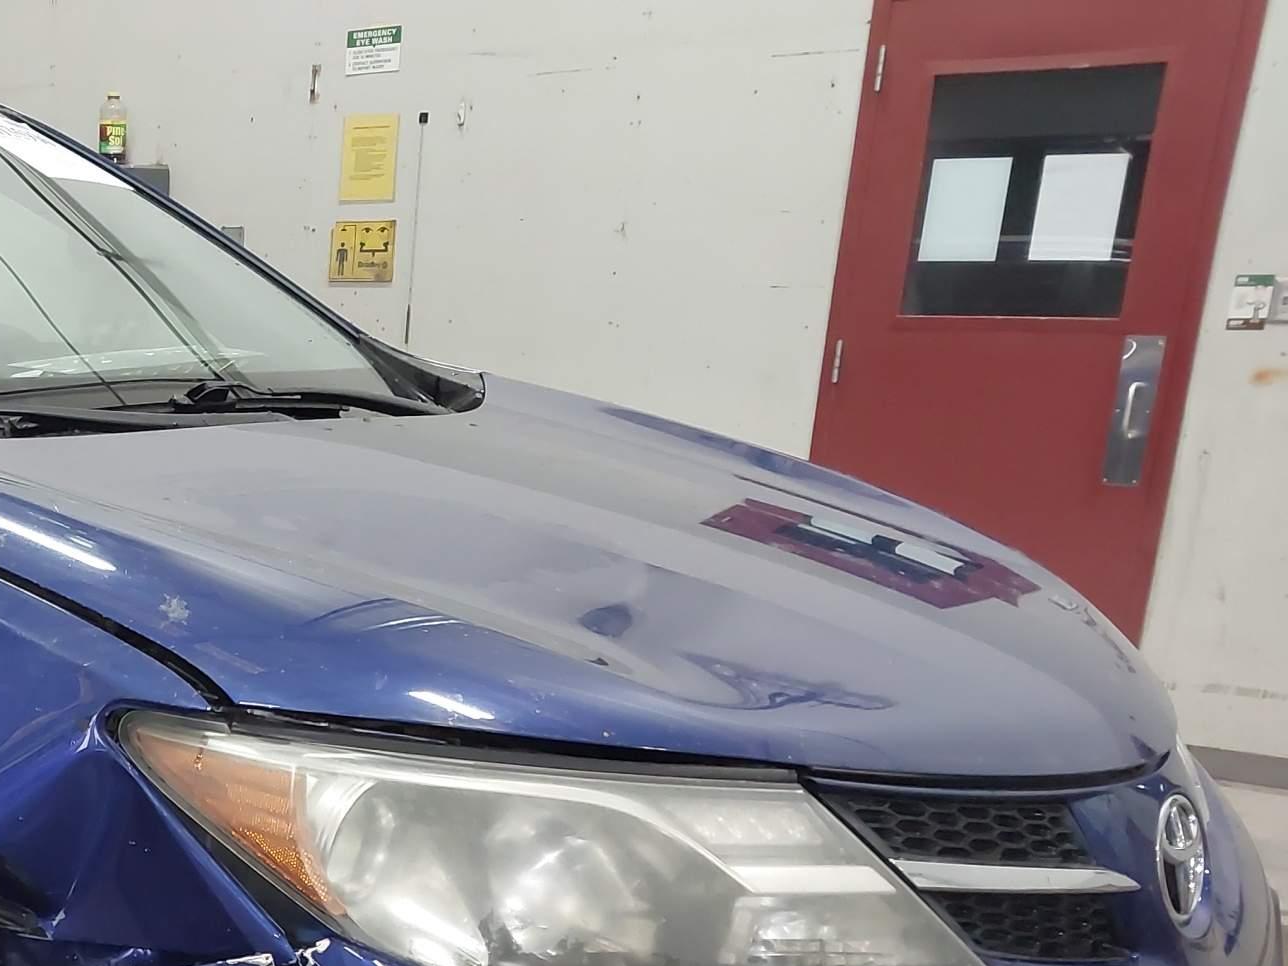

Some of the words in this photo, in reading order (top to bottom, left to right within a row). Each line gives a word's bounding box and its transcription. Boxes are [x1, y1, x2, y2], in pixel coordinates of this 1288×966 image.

[352, 28, 397, 39] EMERGENCY
[355, 38, 371, 46] EYE
[371, 35, 393, 45] WASH
[108, 135, 123, 146] Sol
